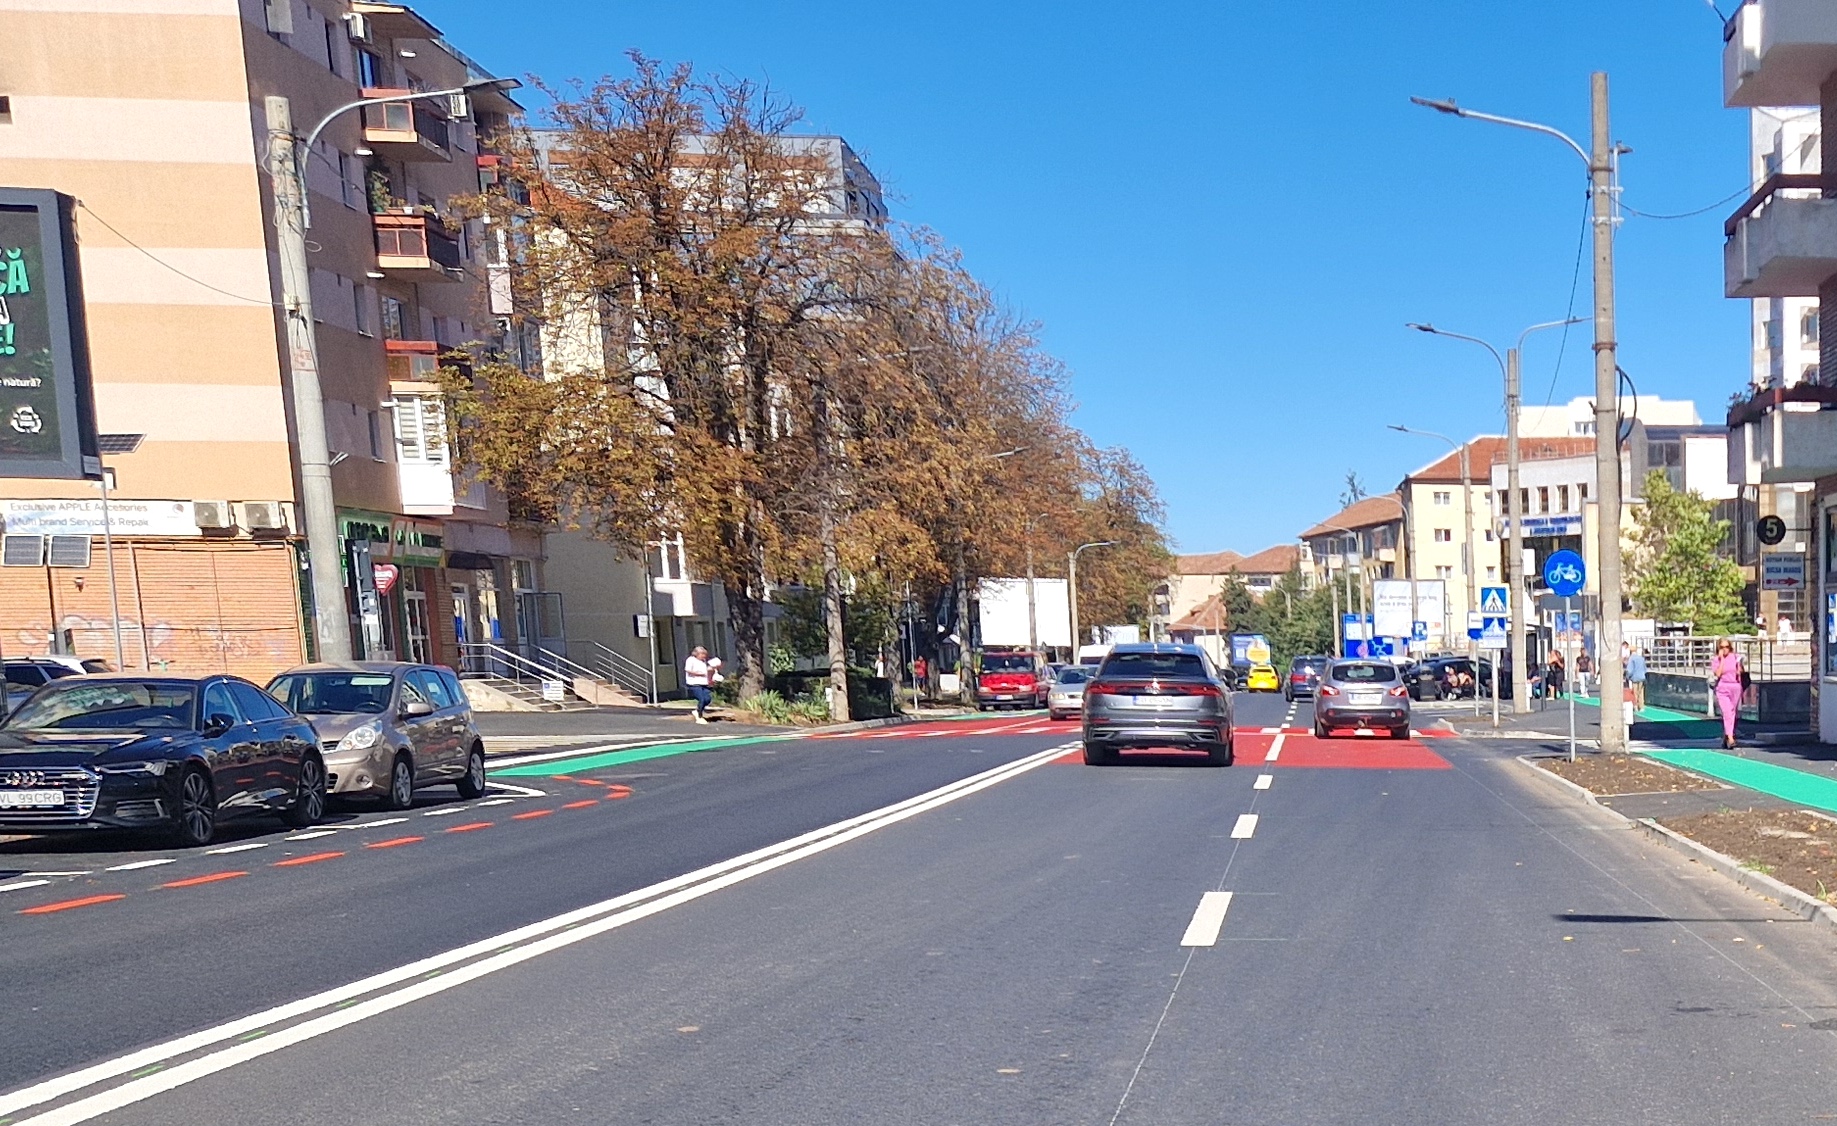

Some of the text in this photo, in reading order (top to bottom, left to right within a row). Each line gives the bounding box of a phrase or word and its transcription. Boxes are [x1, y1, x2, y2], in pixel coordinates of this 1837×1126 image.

[10, 502, 56, 512] Exclusive
[59, 502, 91, 512] APPLE
[39, 516, 68, 526] brand
[69, 517, 106, 527] Service
[109, 517, 116, 526] &
[118, 517, 149, 527] Repair
[1765, 519, 1778, 538] 5
[1415, 622, 1424, 635] P
